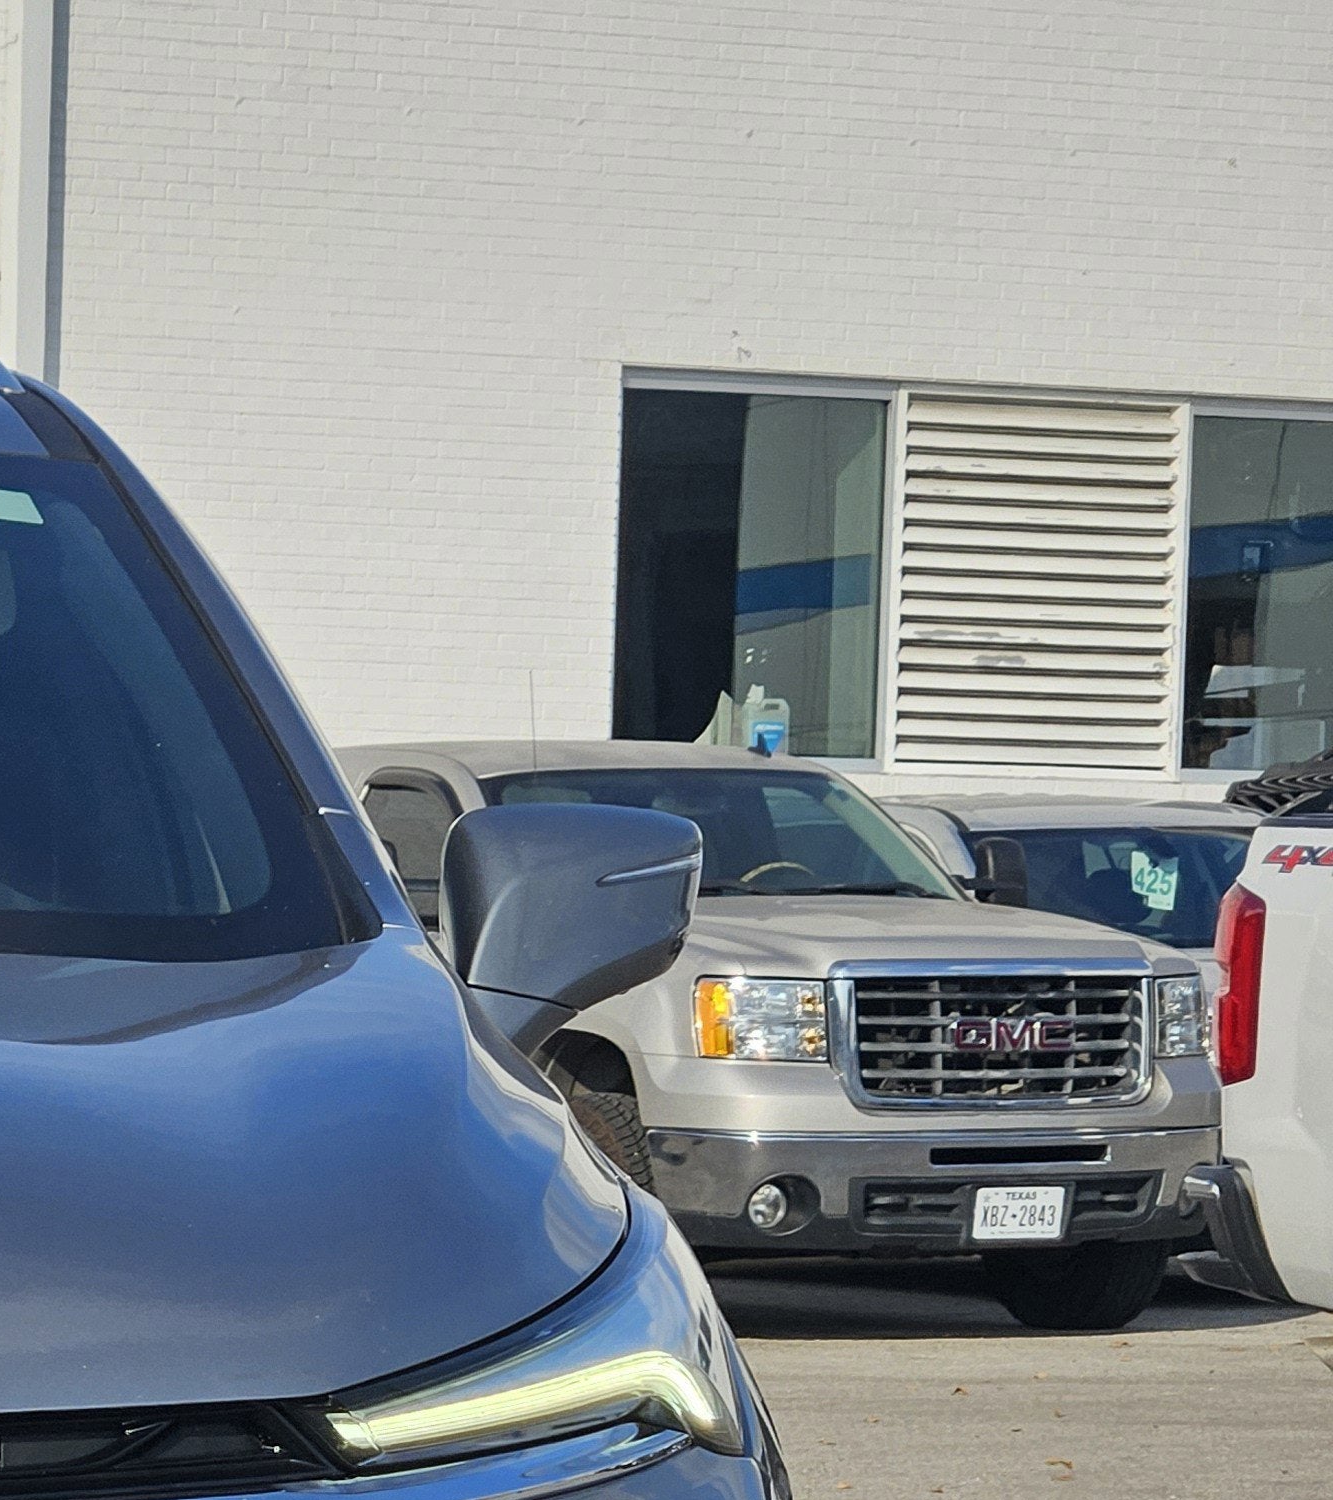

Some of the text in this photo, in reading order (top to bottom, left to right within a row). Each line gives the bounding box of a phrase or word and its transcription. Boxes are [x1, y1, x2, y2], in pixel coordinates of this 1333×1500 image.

[1135, 867, 1172, 895] 425
[950, 1017, 1074, 1051] GMC
[1005, 1191, 1037, 1201] TEXAS
